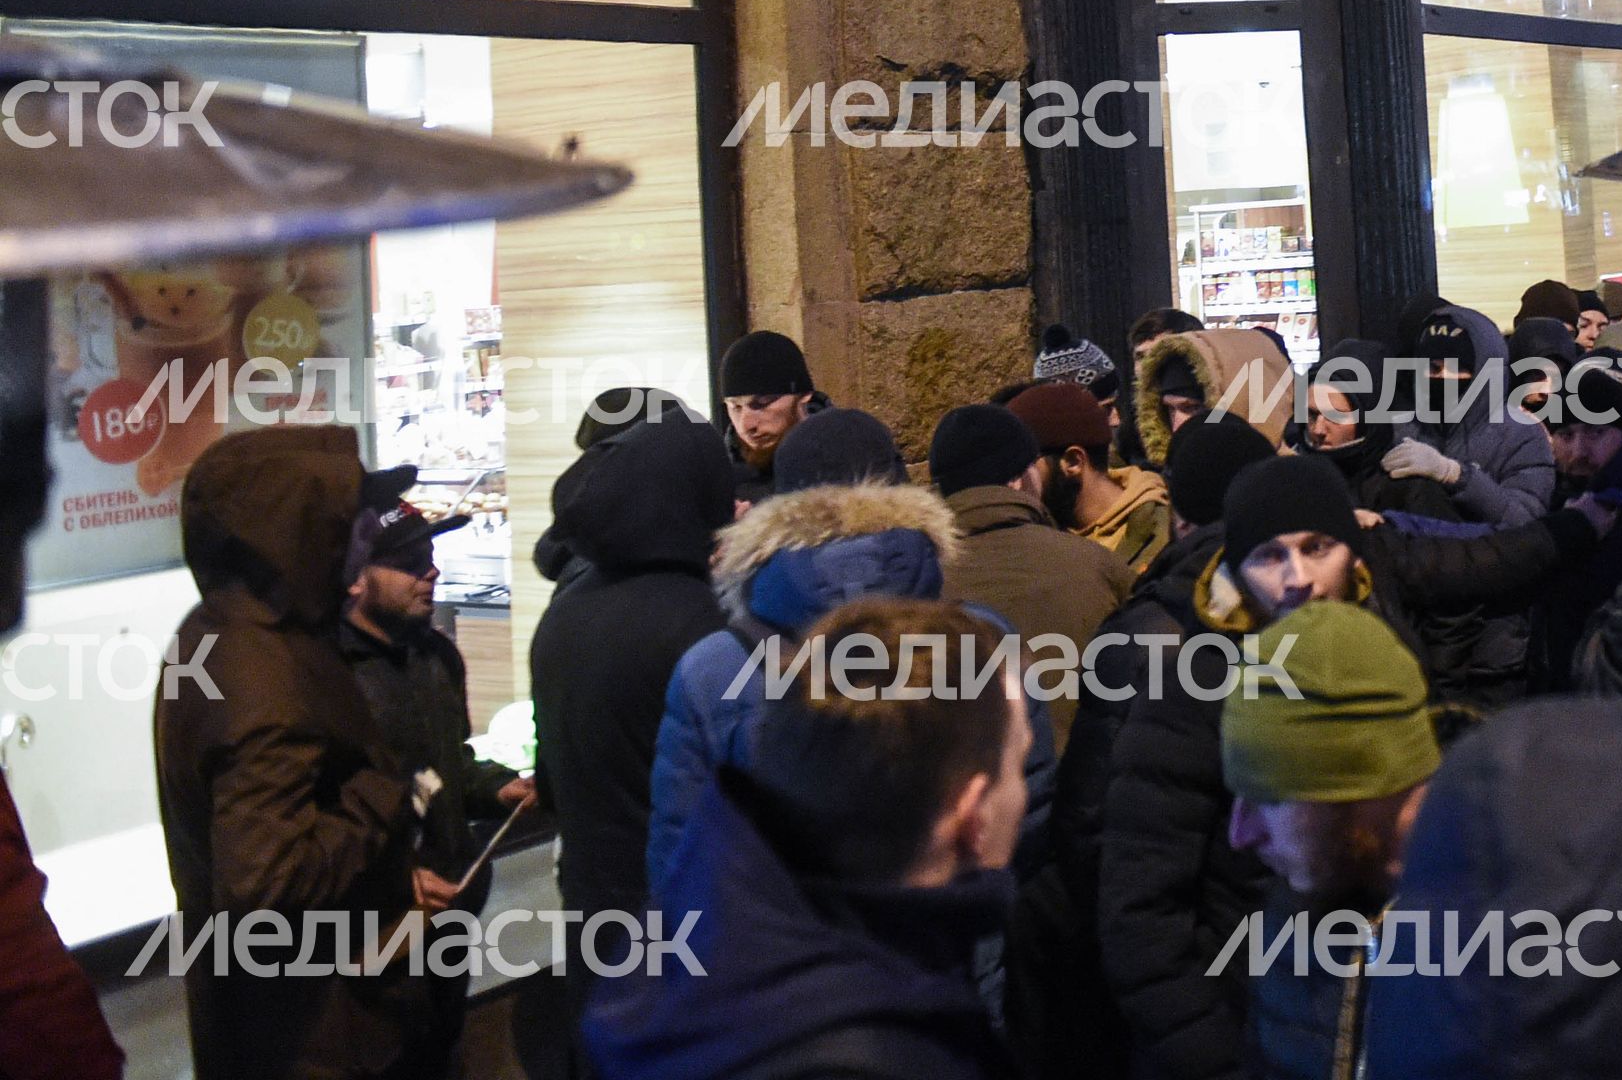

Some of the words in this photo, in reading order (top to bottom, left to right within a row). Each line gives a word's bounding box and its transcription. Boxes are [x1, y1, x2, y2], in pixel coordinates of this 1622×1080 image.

[63, 489, 139, 513] СБИТЕНЬ
[63, 516, 75, 532] С
[79, 496, 179, 530] ОБЛЕПИХОЙ
